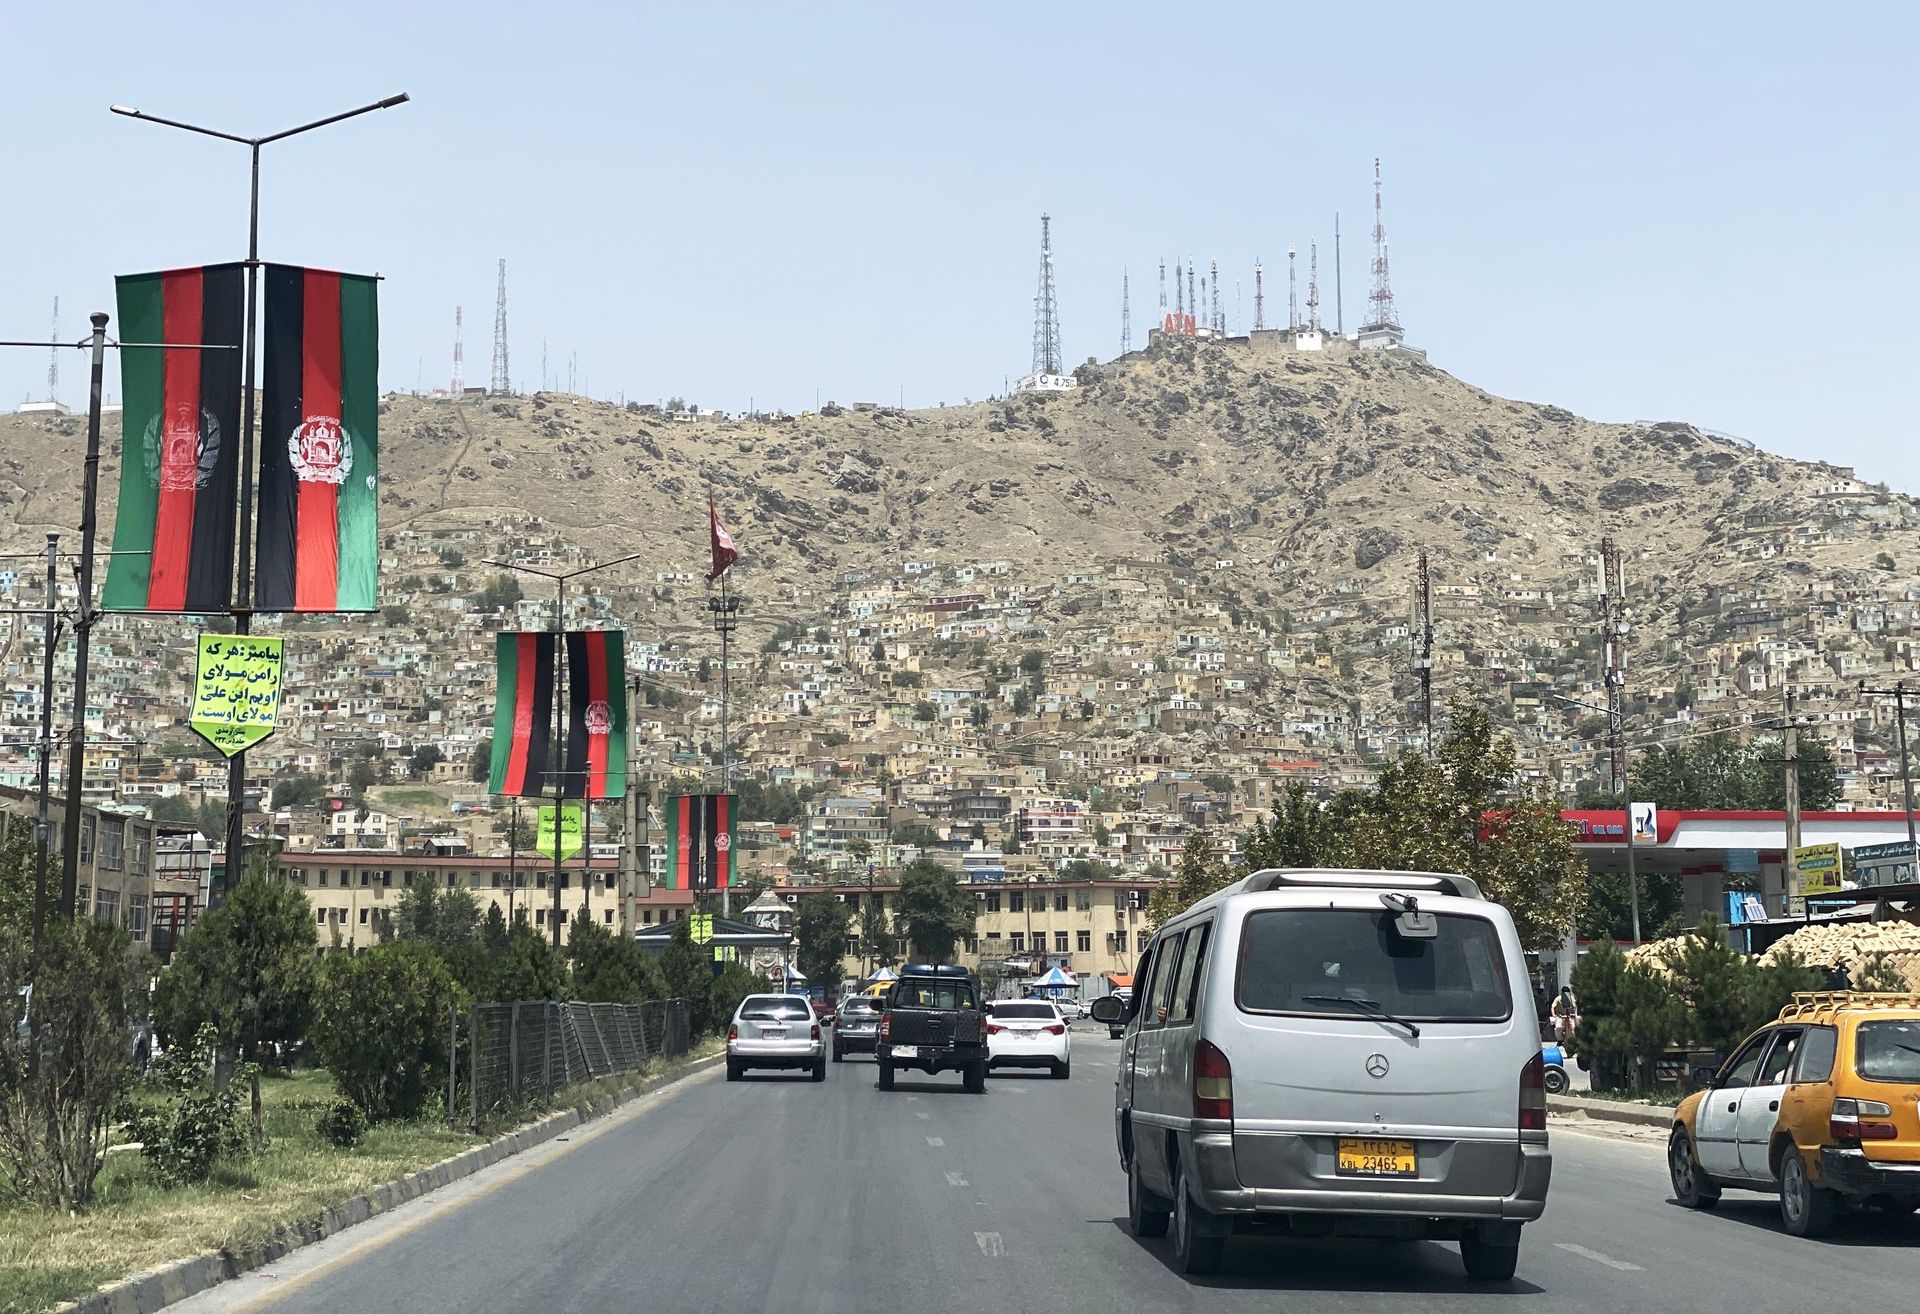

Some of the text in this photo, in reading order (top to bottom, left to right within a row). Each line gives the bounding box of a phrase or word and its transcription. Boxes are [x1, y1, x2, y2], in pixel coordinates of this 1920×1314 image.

[1165, 312, 1195, 336] ATN
[206, 642, 222, 655] که
[1341, 1160, 1359, 1169] KBL
[1363, 1156, 1398, 1171] 23465
